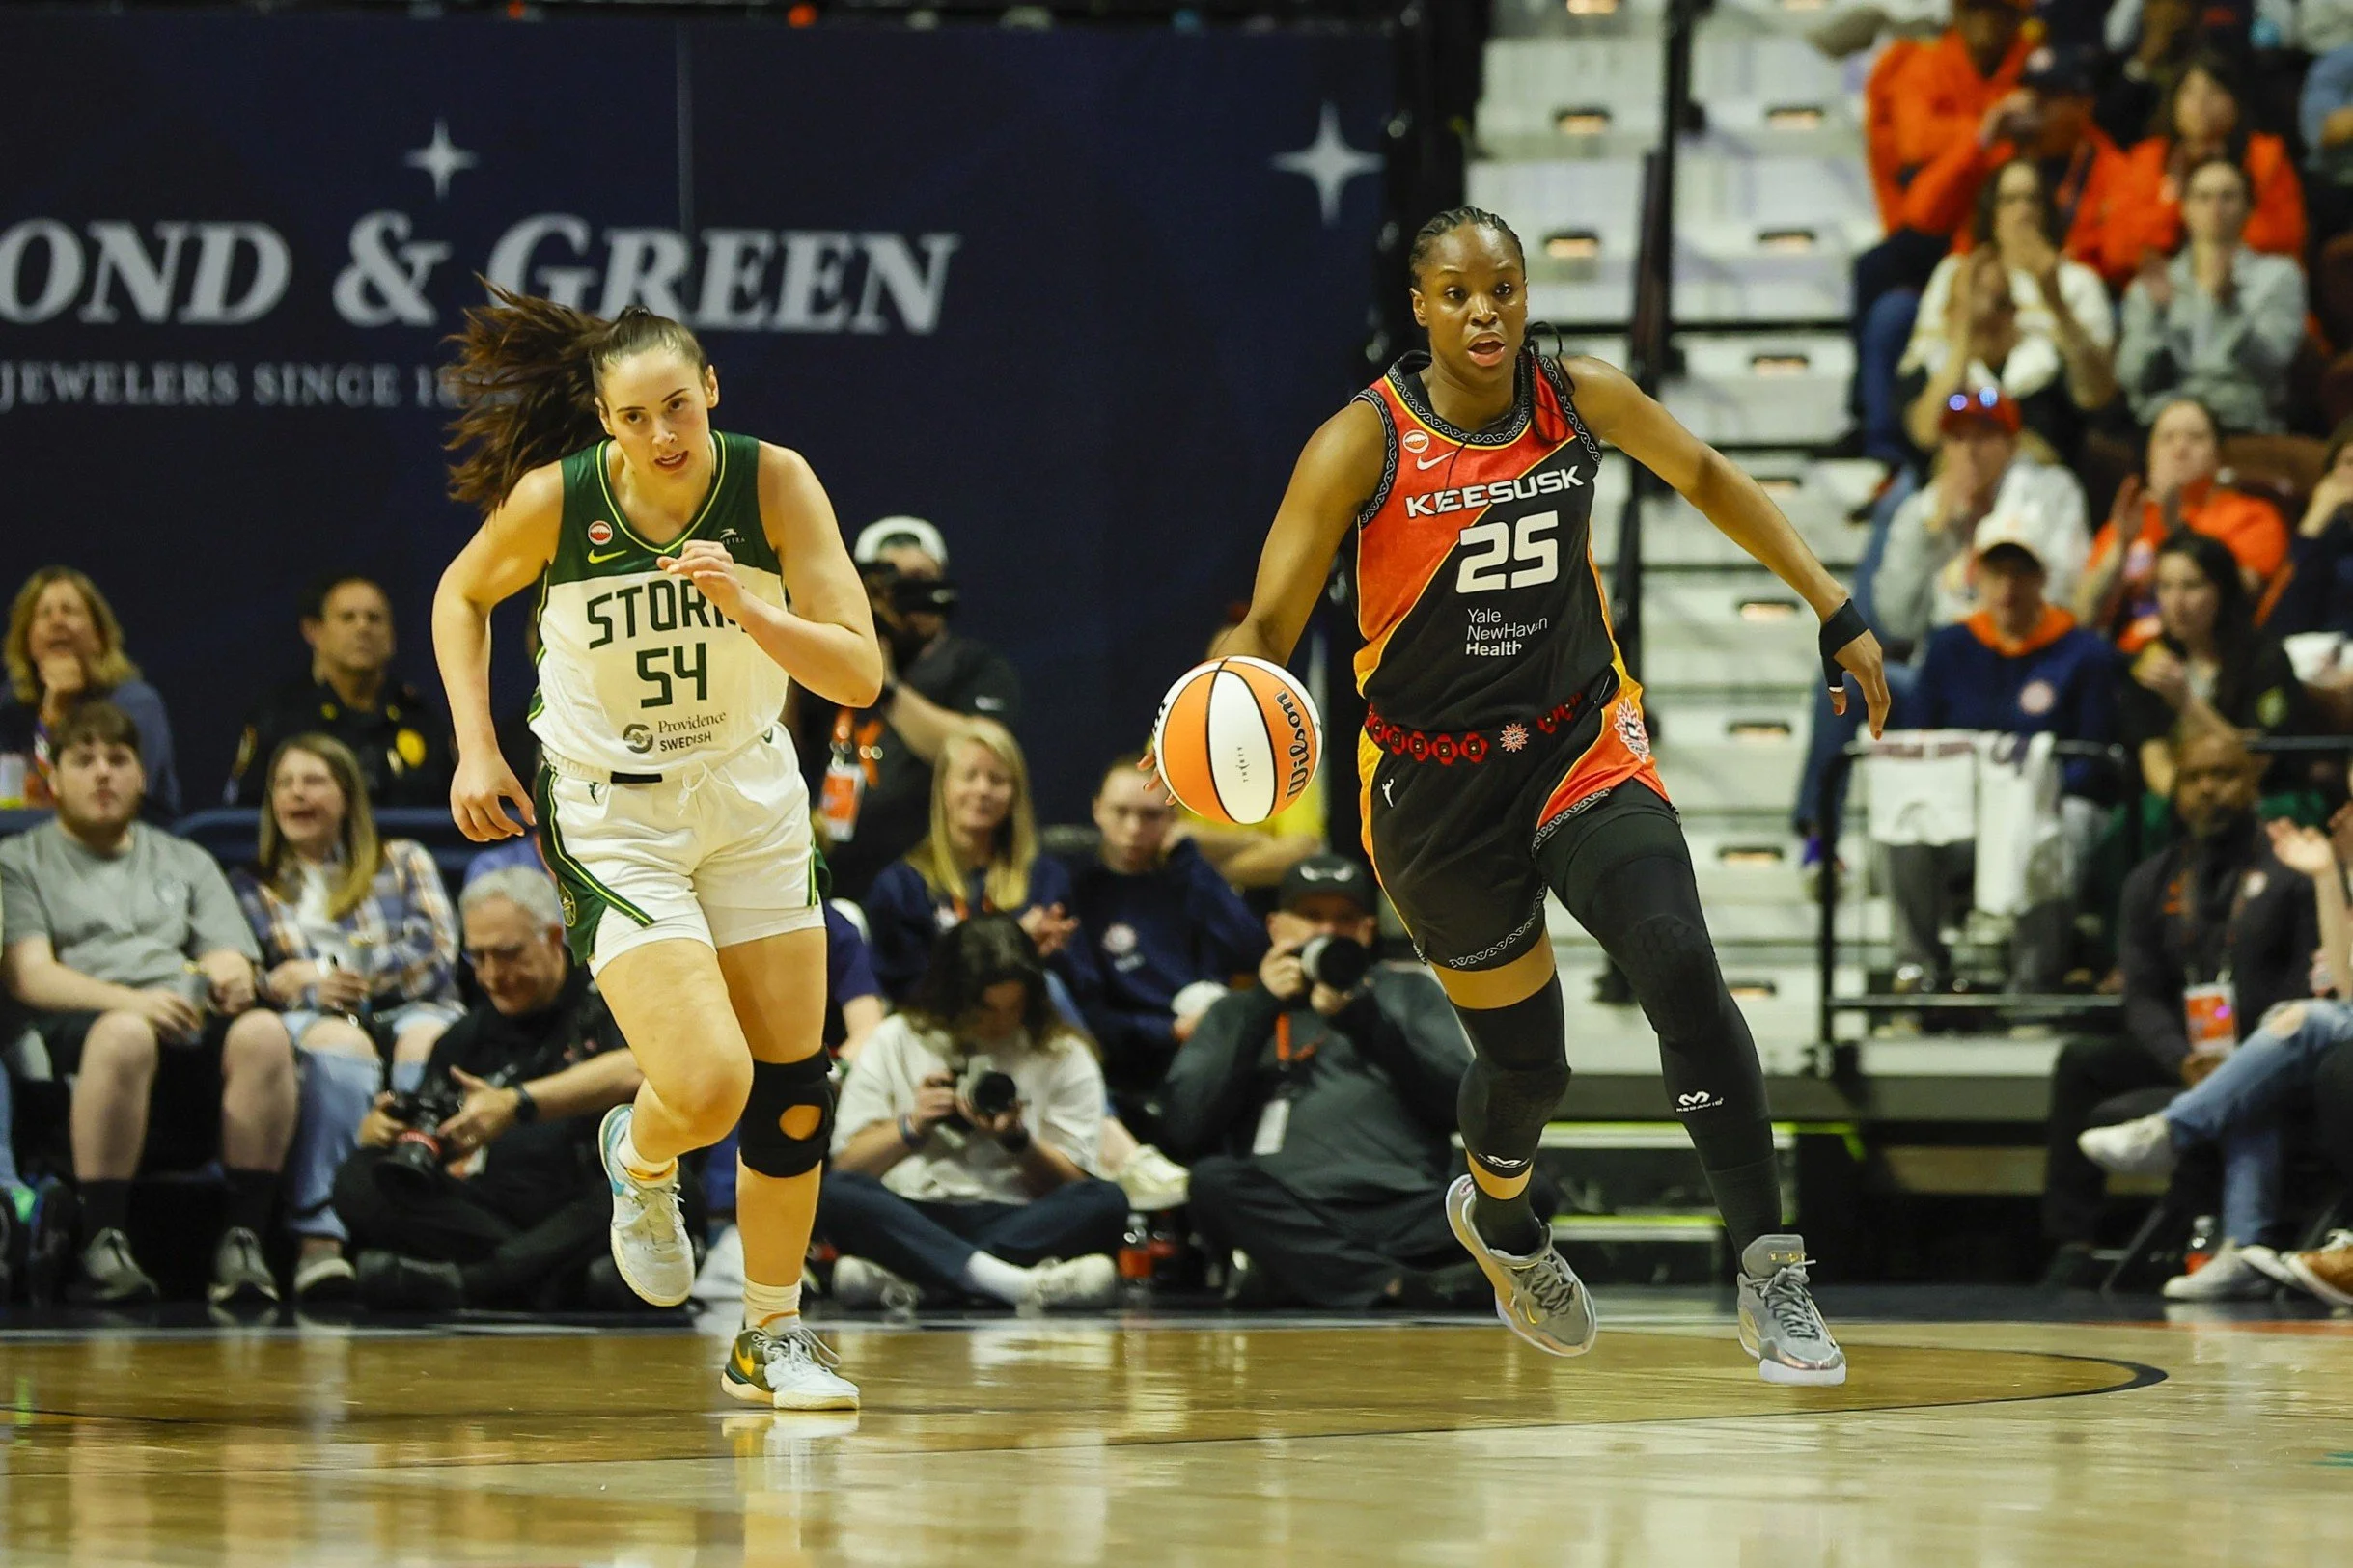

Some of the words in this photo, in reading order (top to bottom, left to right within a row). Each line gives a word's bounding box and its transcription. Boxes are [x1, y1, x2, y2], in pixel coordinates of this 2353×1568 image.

[0, 217, 292, 325] OND
[332, 209, 454, 326] &
[486, 212, 960, 336] GREEN
[0, 360, 240, 414] JEWELERS
[253, 361, 402, 408] SINCE
[1405, 465, 1584, 519] KEESUSK
[1455, 510, 1559, 593] 25
[587, 579, 747, 649] STOR
[1467, 607, 1501, 623] Yale
[636, 642, 707, 708] 54
[1465, 640, 1523, 656] Health
[659, 731, 712, 752] SWEDISH
[1274, 689, 1310, 800] Wilson
